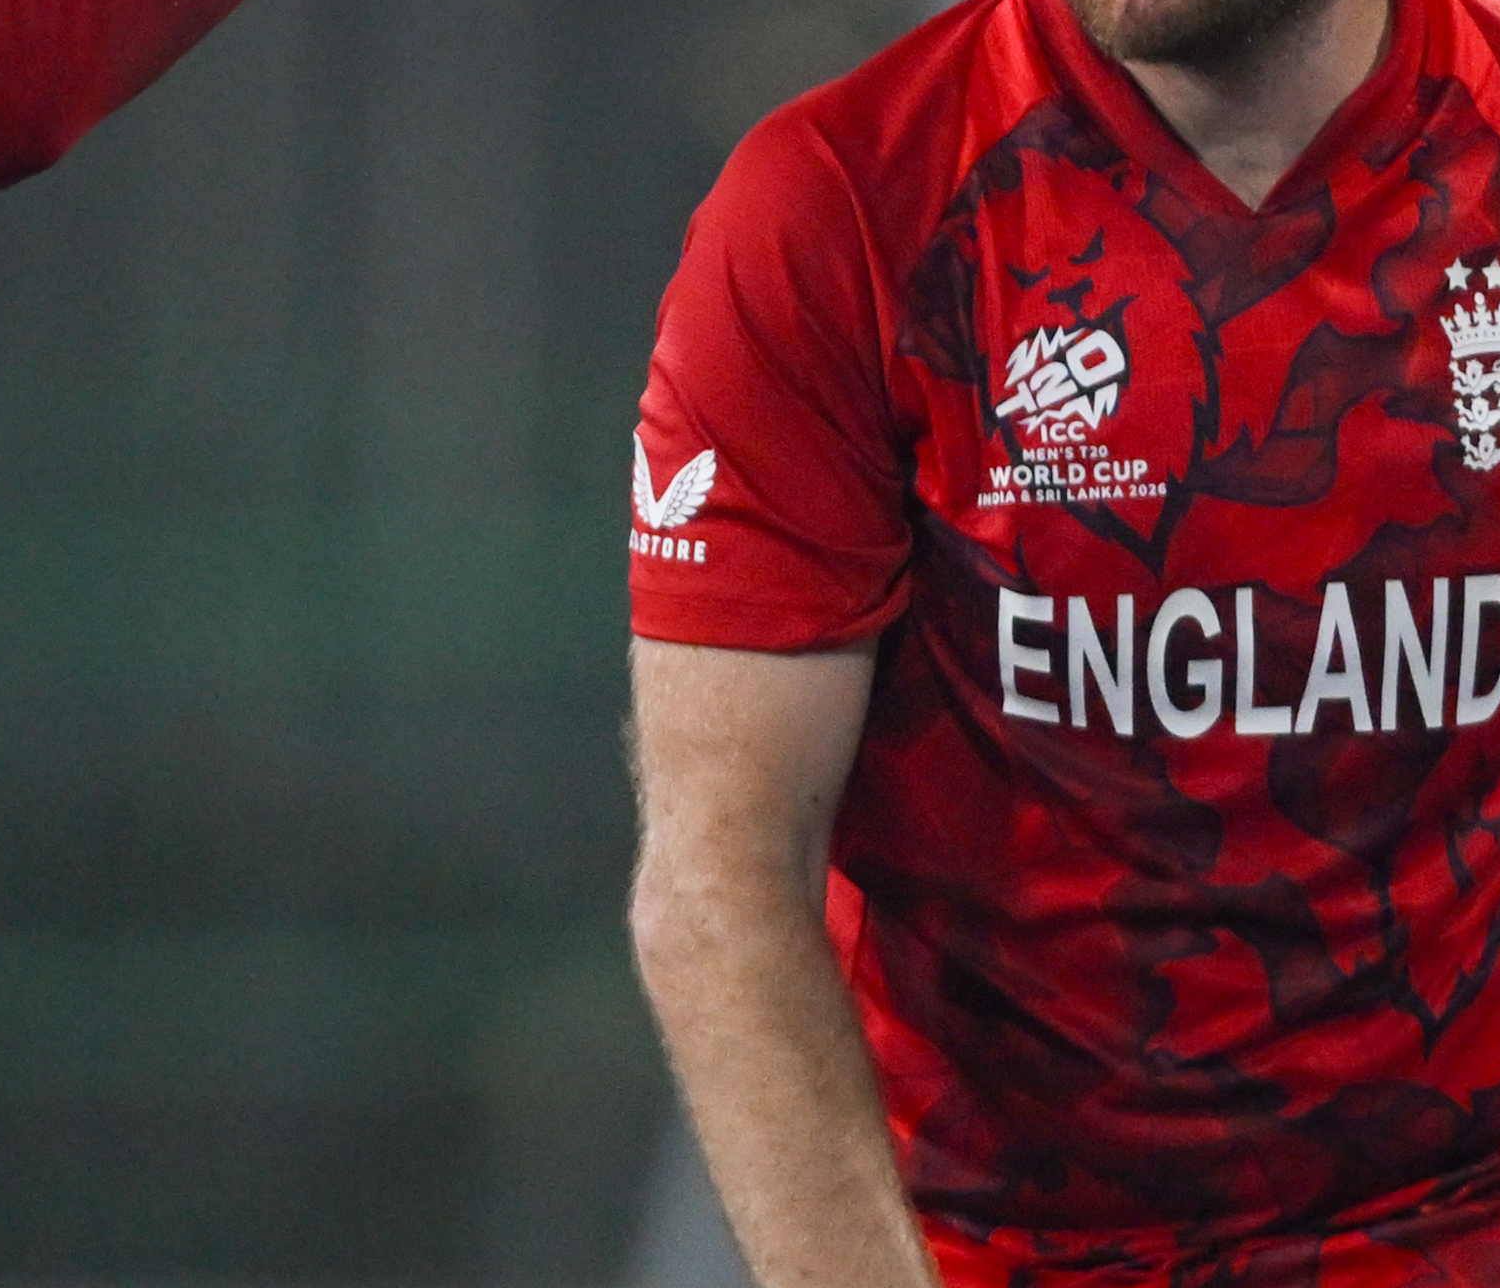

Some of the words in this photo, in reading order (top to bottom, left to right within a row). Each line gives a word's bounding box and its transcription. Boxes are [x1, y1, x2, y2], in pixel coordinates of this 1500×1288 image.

[1040, 420, 1086, 443] ICC
[1022, 446, 1075, 462] MEN'S
[1079, 444, 1109, 459] T20
[989, 463, 1086, 488] WORLD
[1093, 459, 1149, 483] CUP
[977, 489, 1016, 507] INDIA
[1021, 489, 1032, 502] &
[1036, 487, 1062, 502] SRI
[1066, 484, 1124, 501] LANKA
[1129, 482, 1167, 497] 2026
